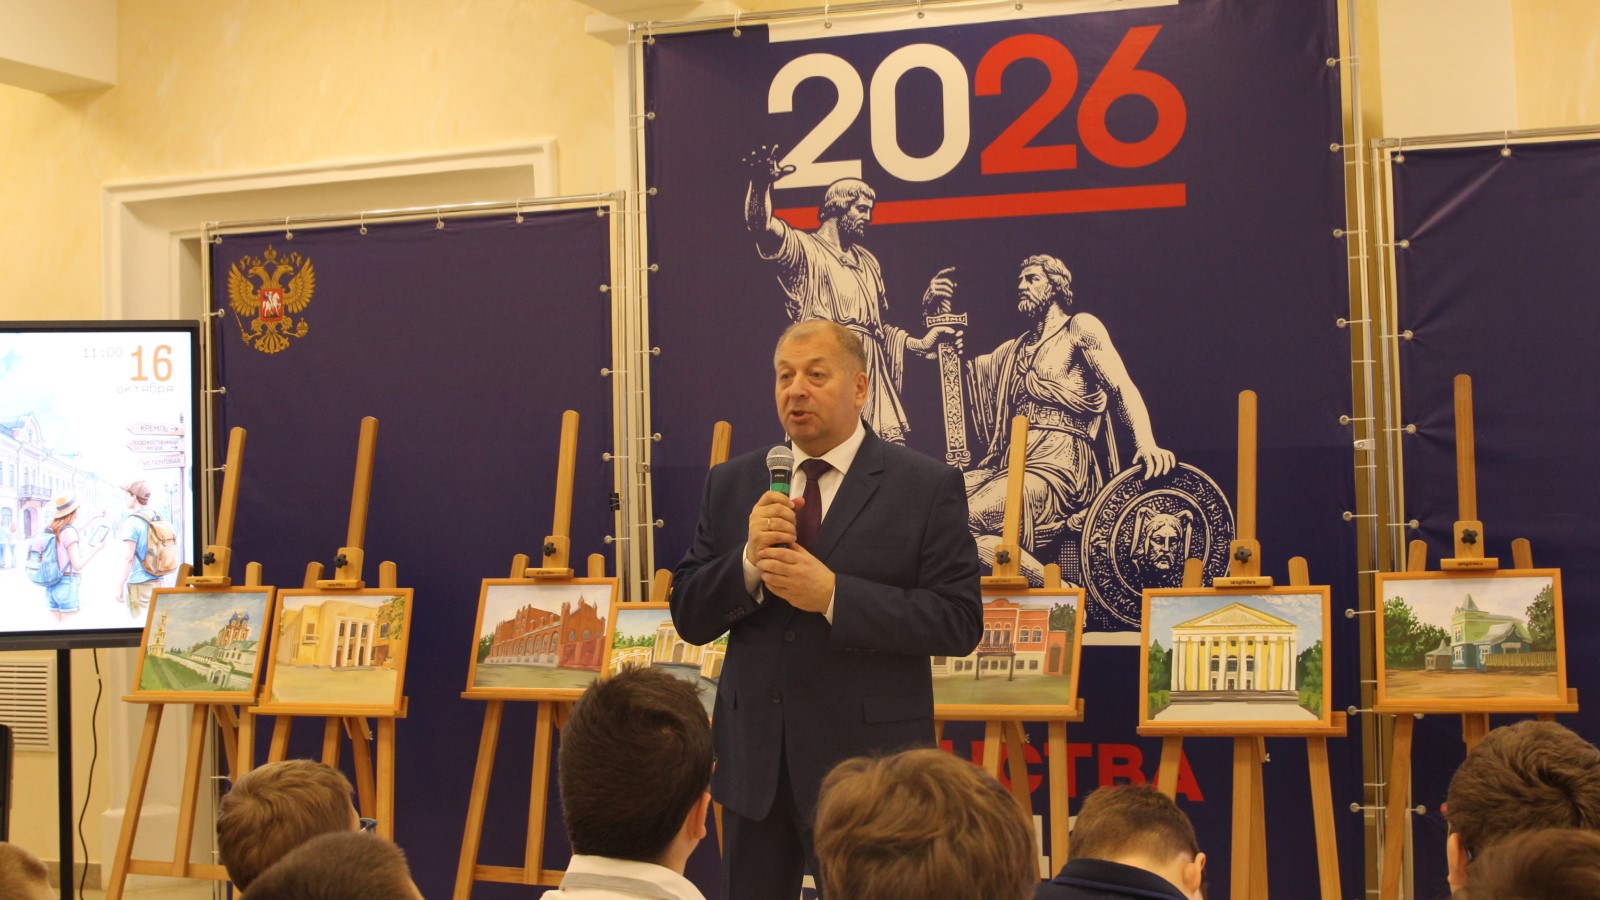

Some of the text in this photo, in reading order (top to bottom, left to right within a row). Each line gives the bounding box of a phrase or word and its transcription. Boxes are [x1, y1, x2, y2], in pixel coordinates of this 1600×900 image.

[768, 25, 1187, 190] 2026
[83, 347, 123, 358] 11:00
[131, 344, 173, 382] 16
[116, 383, 174, 396] октября
[140, 424, 169, 432] КРЕМЛЬ
